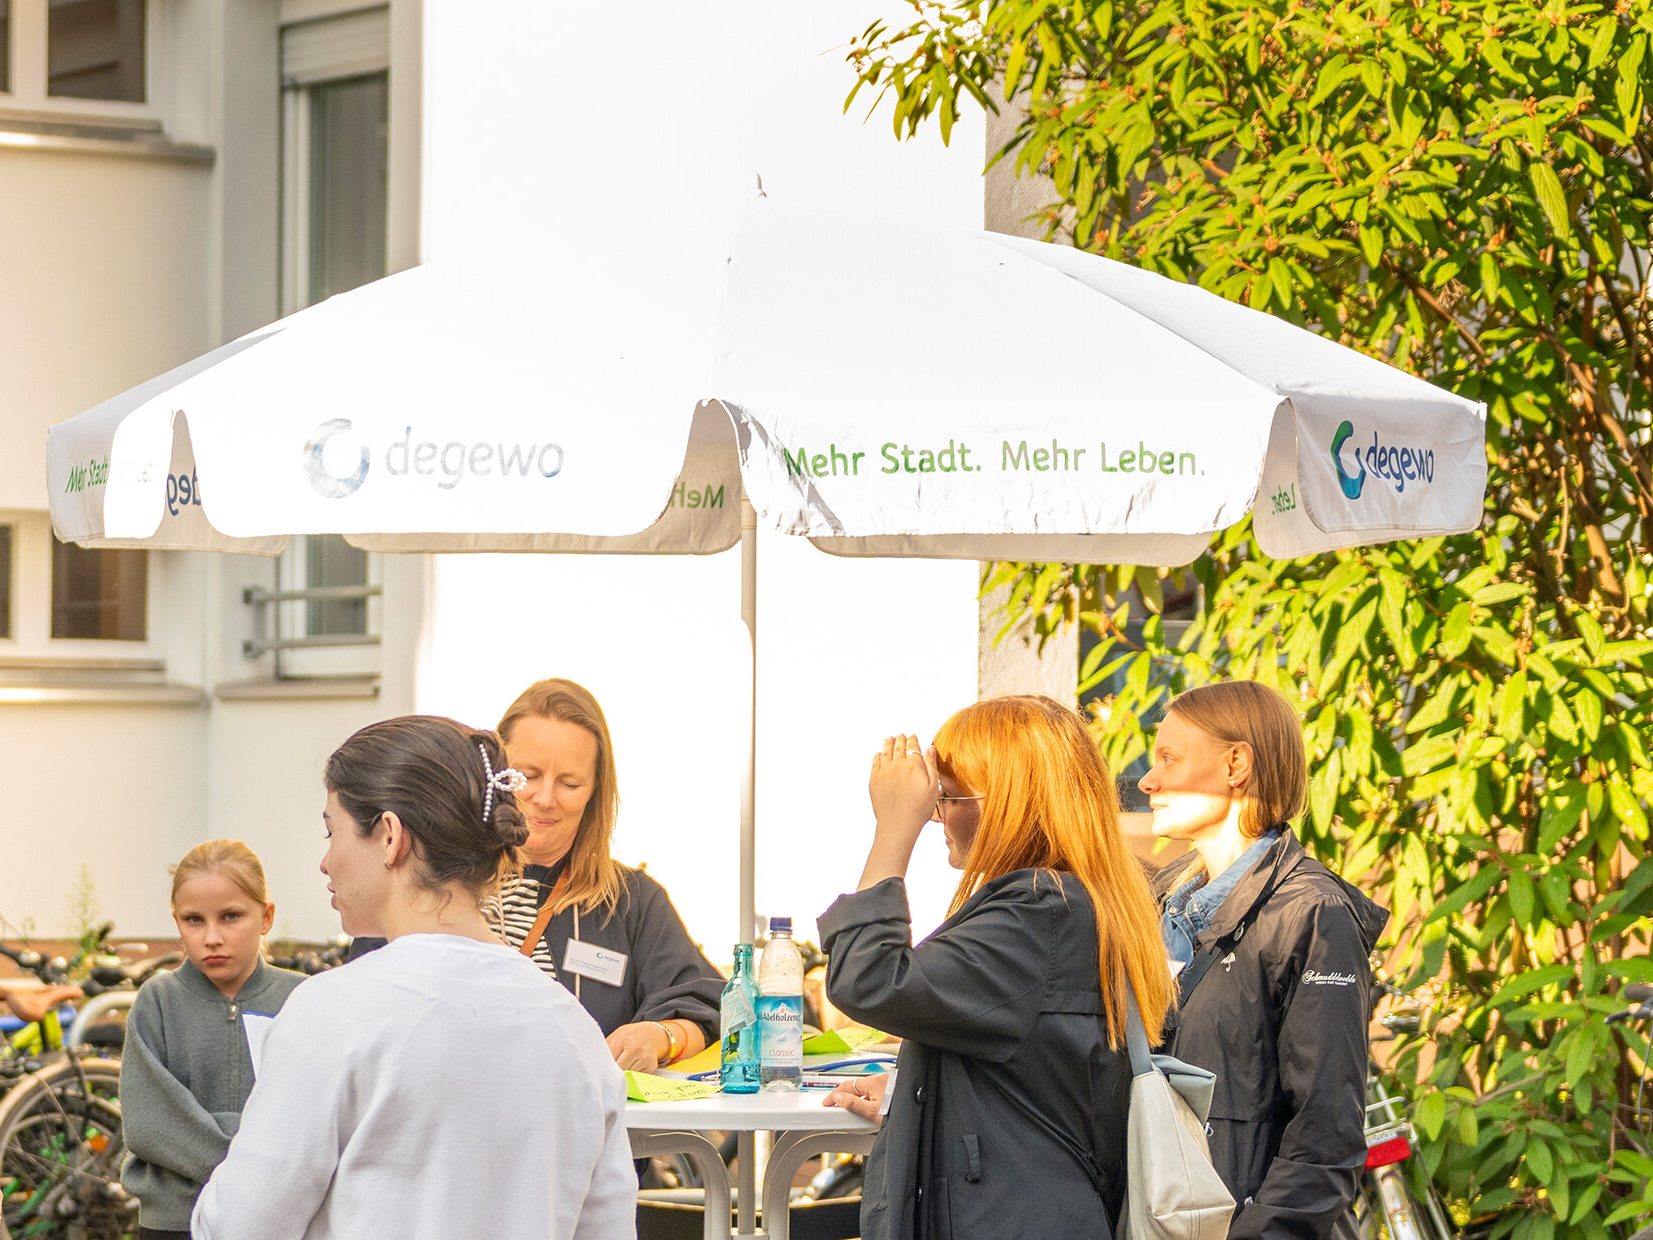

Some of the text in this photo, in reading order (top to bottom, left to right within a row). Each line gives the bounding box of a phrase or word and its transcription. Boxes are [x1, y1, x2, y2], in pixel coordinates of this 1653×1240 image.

[65, 462, 87, 493] Mehr
[386, 426, 565, 490] degewo
[784, 438, 1206, 479] Mehr Stadt. Mehr Leben.
[1365, 430, 1434, 492] degewo
[769, 1048, 795, 1056] classic
